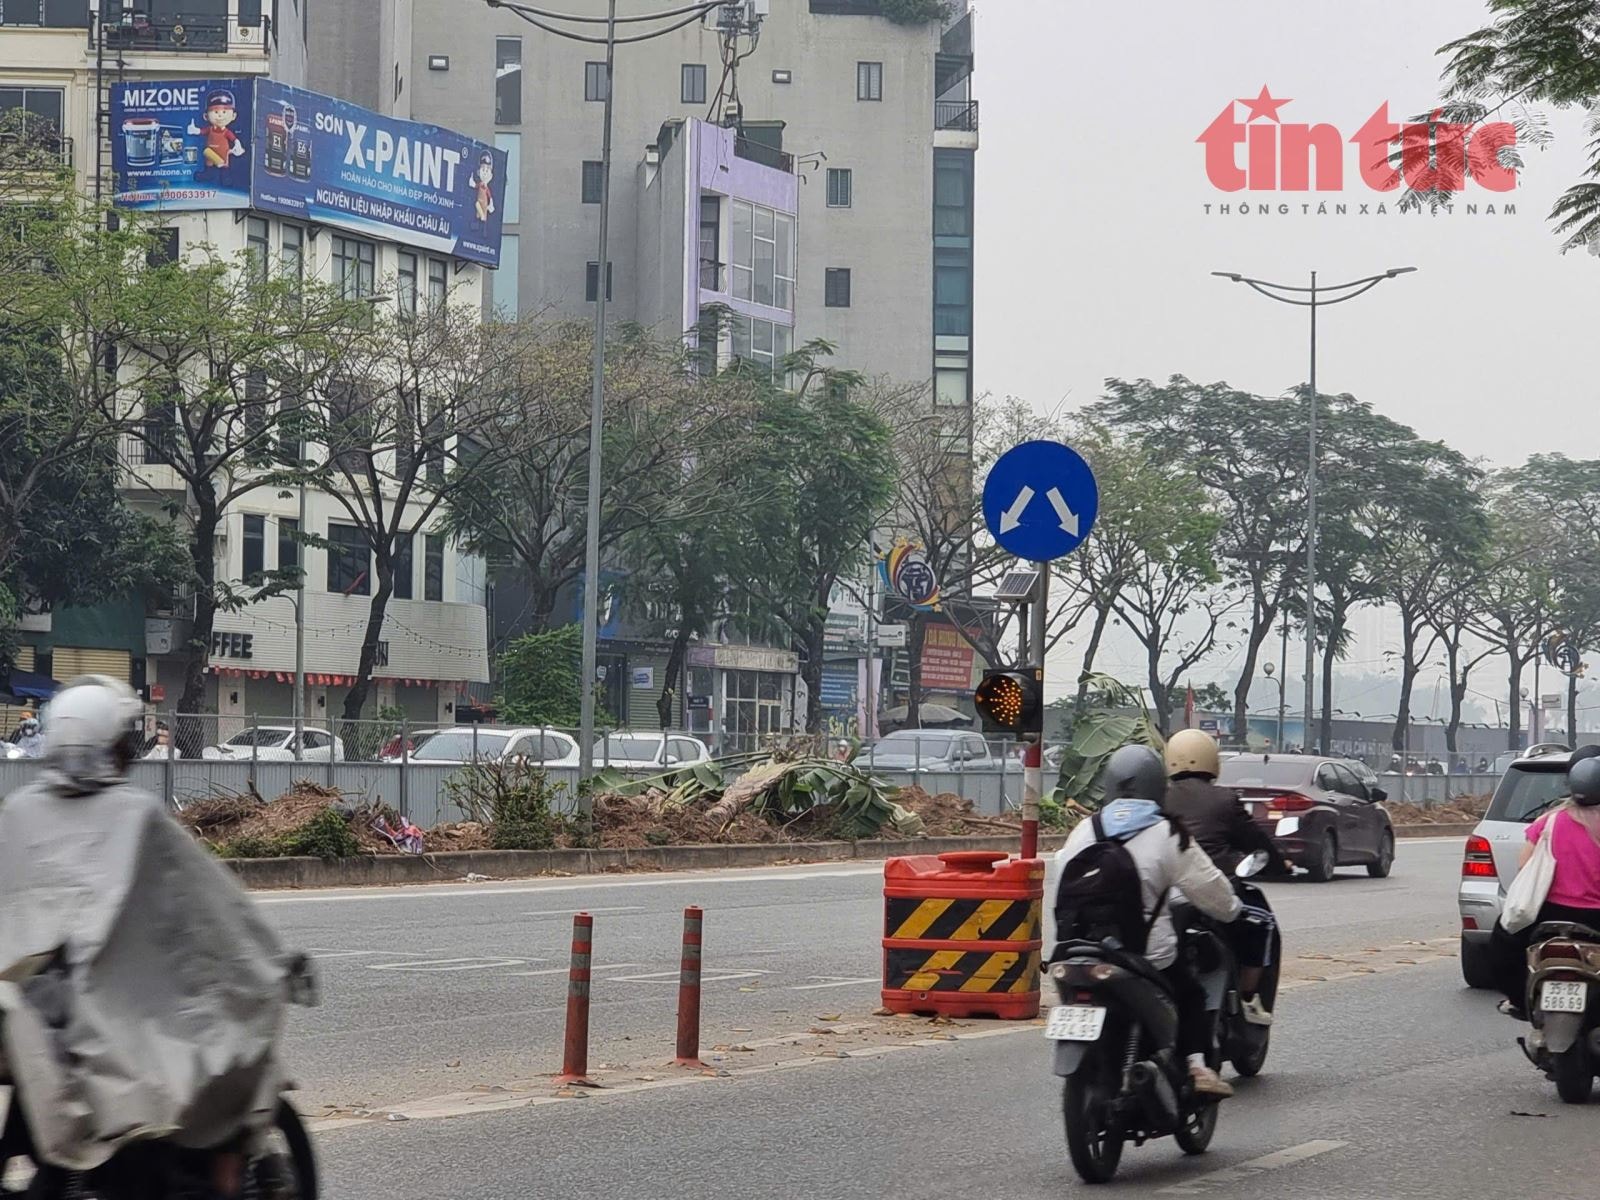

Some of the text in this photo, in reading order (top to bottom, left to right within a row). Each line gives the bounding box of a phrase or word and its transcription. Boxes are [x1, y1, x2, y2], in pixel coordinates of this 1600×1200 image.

[124, 88, 198, 107] MIZONE
[315, 112, 343, 136] SƠN
[378, 181, 392, 193] CHO
[438, 196, 454, 208] XINH
[316, 188, 349, 210] NGUYÊN
[351, 196, 369, 216] LIỆU
[370, 202, 392, 222] NHẬP
[416, 214, 438, 231] CHÂU
[438, 217, 450, 235] ÂU
